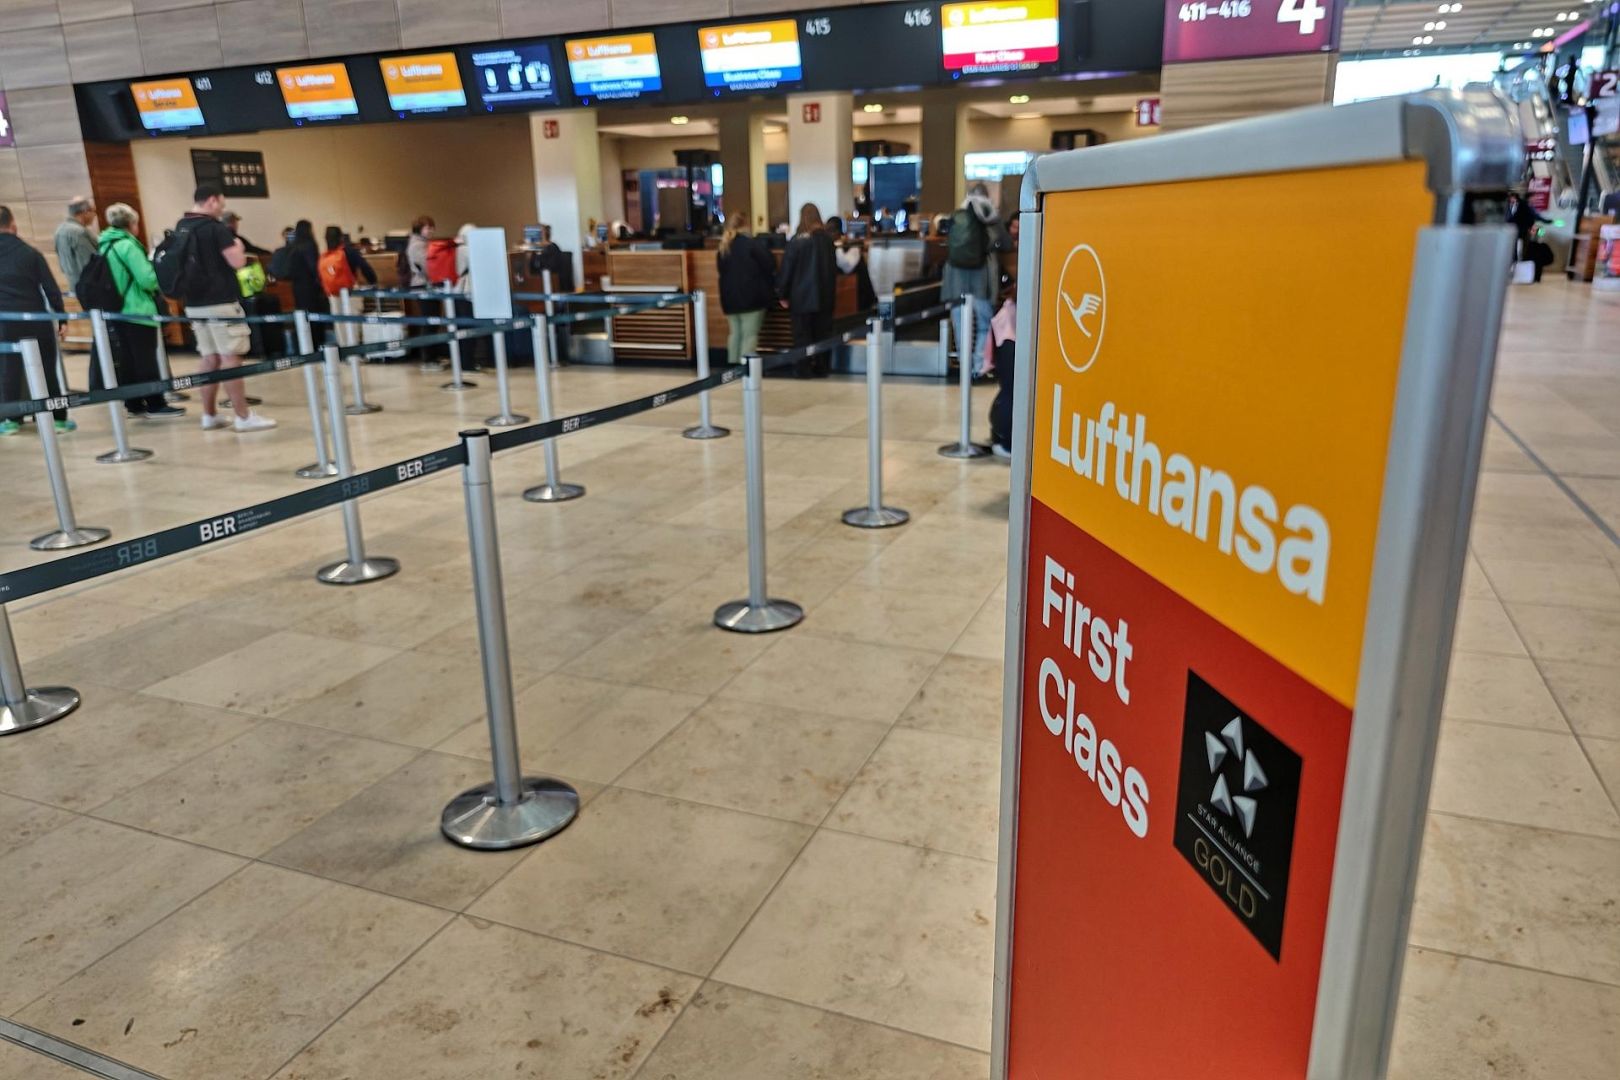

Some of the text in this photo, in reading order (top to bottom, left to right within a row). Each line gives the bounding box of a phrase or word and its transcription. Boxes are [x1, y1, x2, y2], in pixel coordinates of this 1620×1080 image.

[805, 17, 831, 35] 415
[904, 8, 932, 27] 416
[1276, 0, 1326, 35] 4
[562, 417, 580, 433] BER
[398, 460, 424, 480] BER
[1050, 383, 1331, 606] Lufthansa
[200, 516, 236, 541] BER
[1042, 554, 1133, 705] First
[1038, 656, 1150, 839] Class
[1197, 803, 1261, 875] STAR ALLIANCE
[1194, 837, 1257, 919] GOLD
